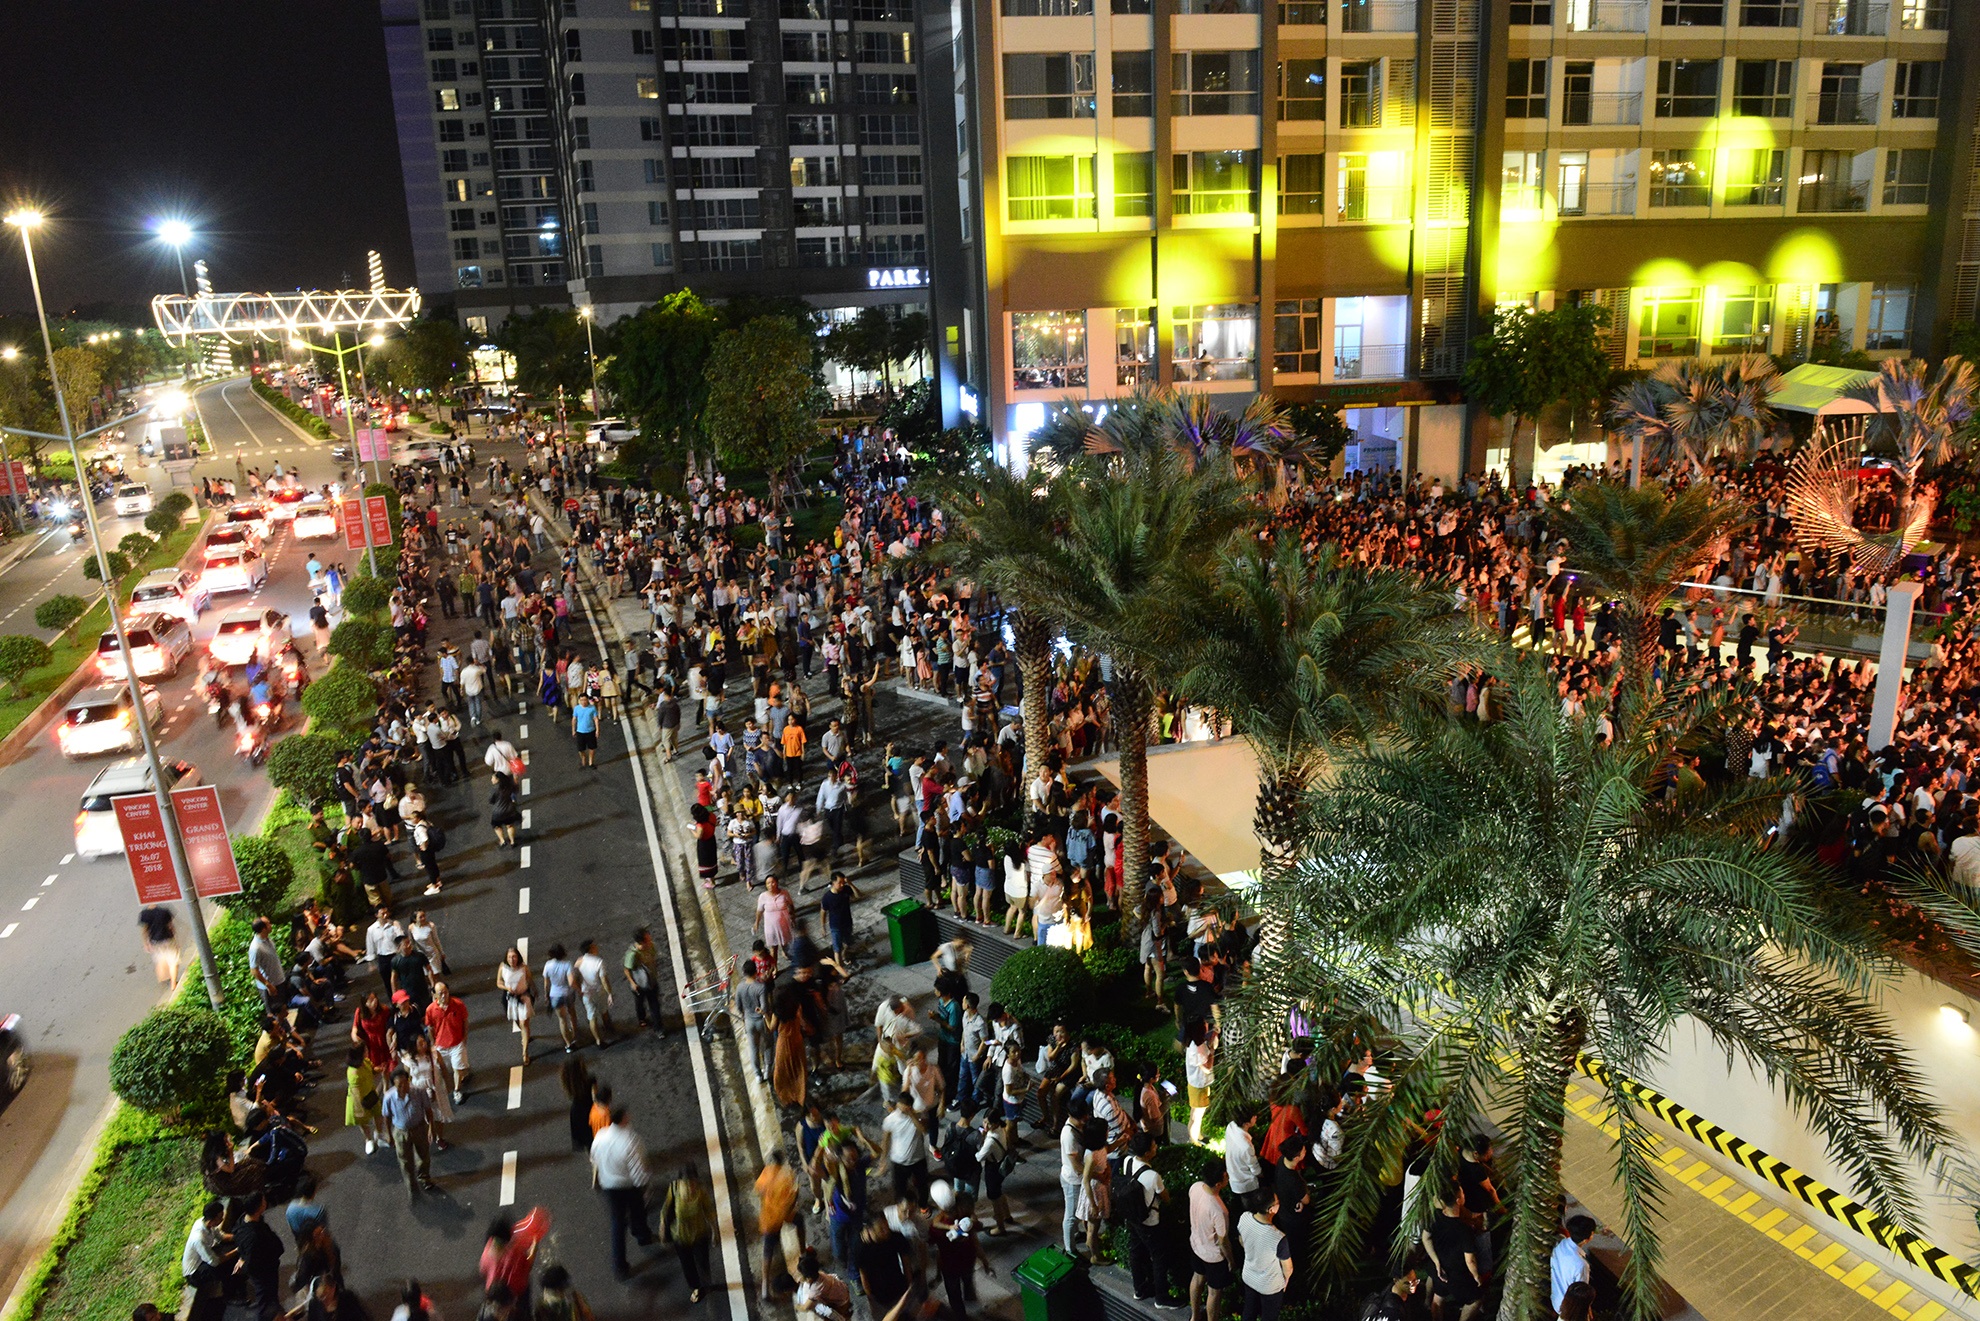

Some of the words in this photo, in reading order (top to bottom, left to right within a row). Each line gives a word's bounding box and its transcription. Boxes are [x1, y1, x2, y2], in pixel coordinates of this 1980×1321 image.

[869, 269, 921, 286] PARK
[181, 796, 208, 804] VINCOM
[123, 803, 150, 811] VINCOM
[183, 802, 208, 810] CENTER
[125, 810, 150, 818] CENTER
[185, 823, 219, 834] GRAND
[185, 833, 225, 845] OPENING
[143, 863, 163, 873] 2018
